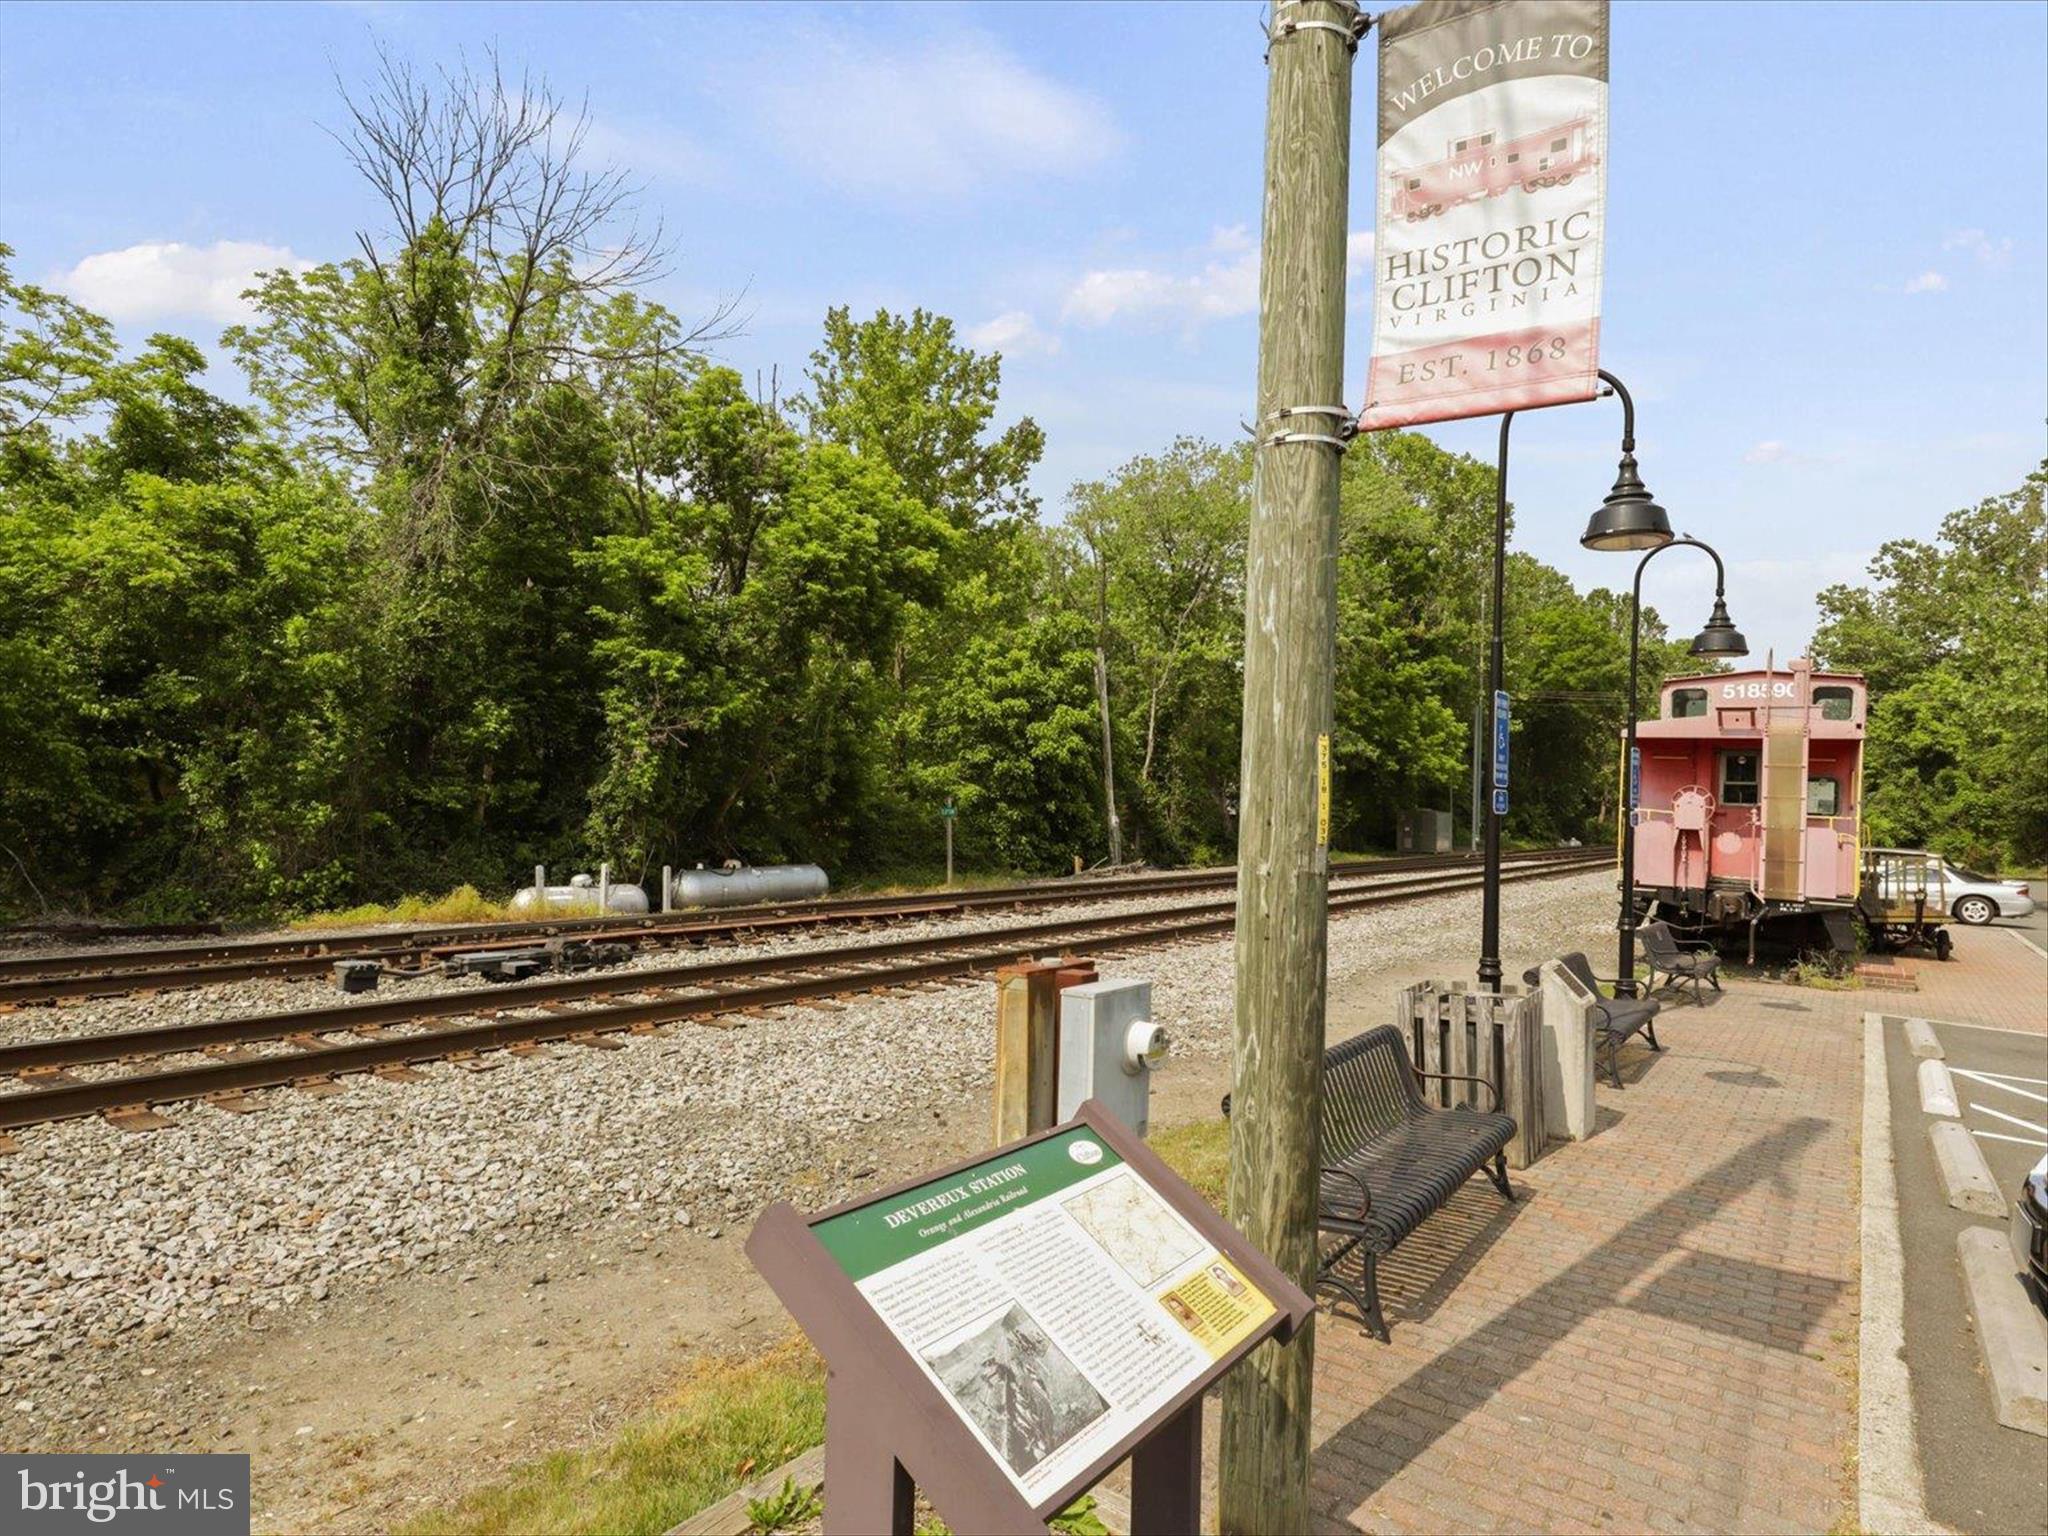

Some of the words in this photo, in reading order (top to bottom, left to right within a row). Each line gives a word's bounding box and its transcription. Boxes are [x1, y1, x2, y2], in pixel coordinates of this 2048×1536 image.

[1391, 36, 1543, 112] WELCOME
[1551, 34, 1593, 59] TO
[1449, 159, 1484, 180] NW
[1385, 211, 1590, 282] HISTORIC
[1390, 282, 1578, 329] VIRGINIA
[1392, 248, 1580, 311] CLIFTON
[1397, 354, 1468, 385] EST.
[1486, 336, 1566, 371] 1868
[883, 1186, 970, 1229] DEVEREUX
[968, 1163, 1028, 1195] STATION
